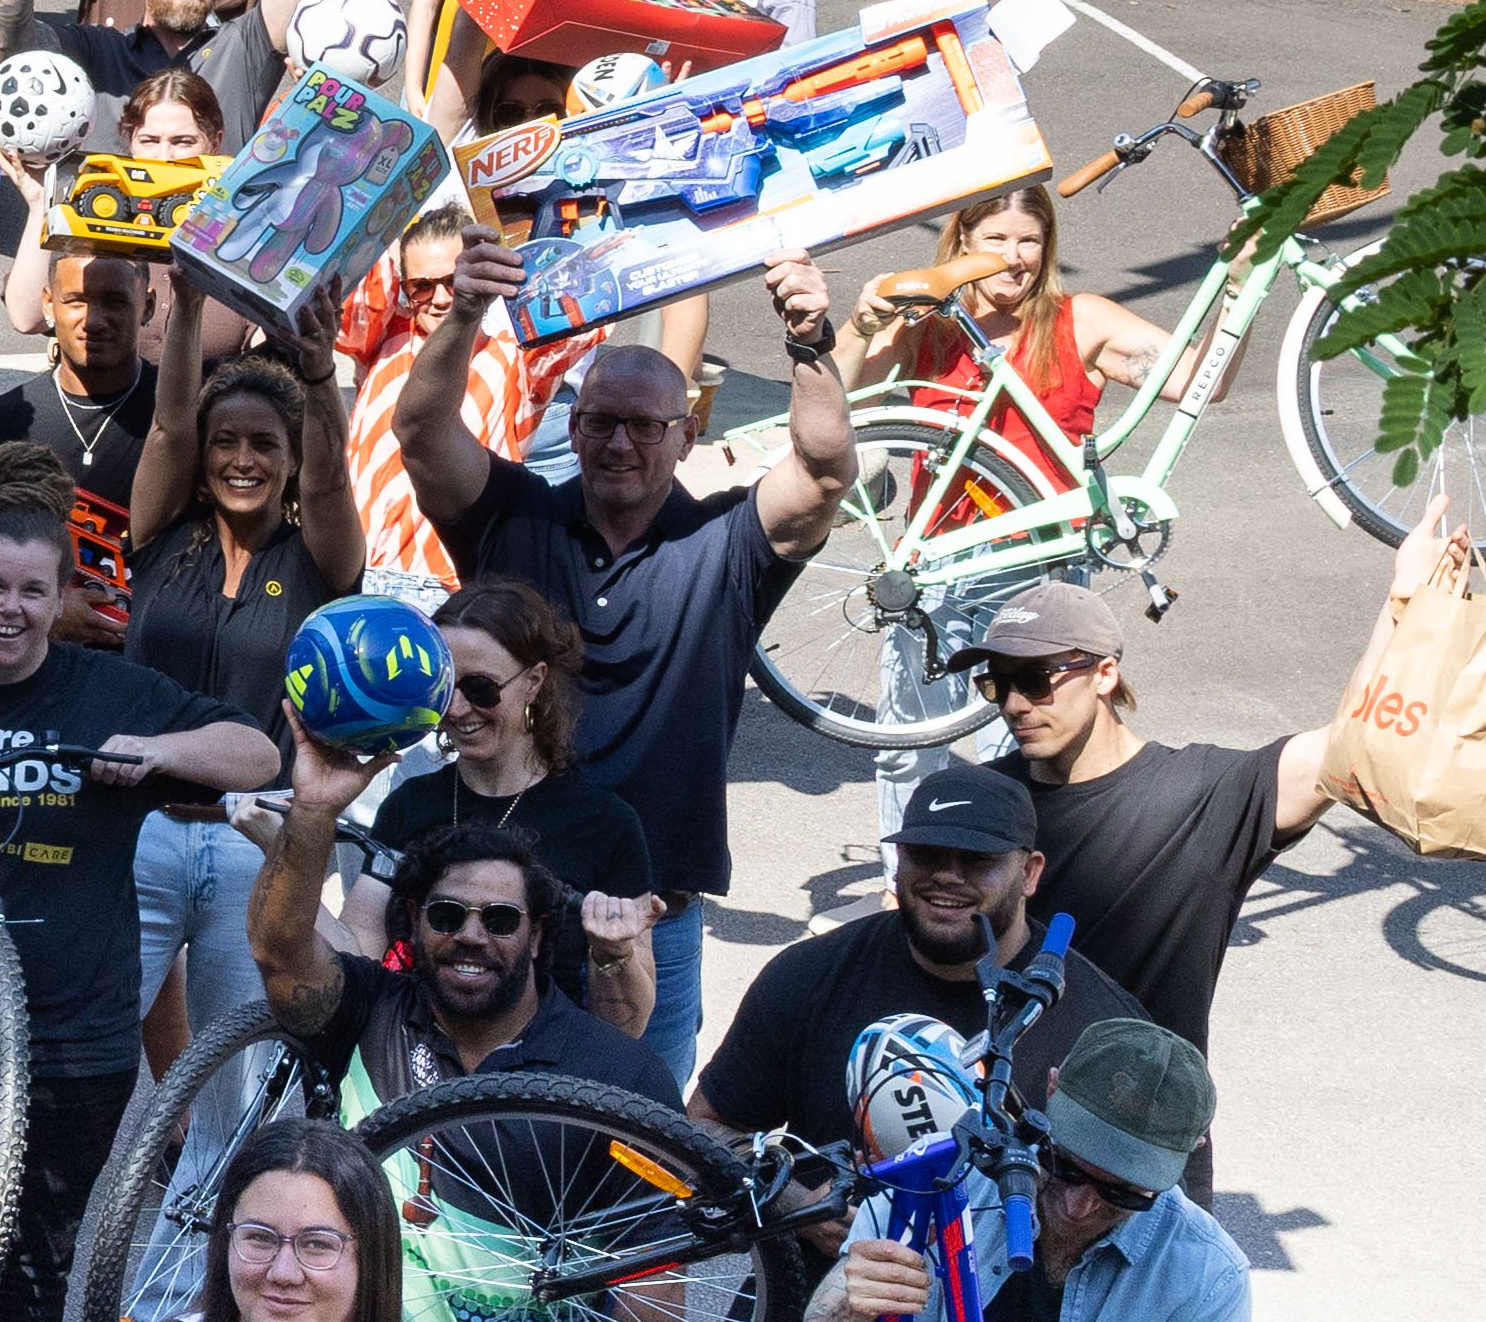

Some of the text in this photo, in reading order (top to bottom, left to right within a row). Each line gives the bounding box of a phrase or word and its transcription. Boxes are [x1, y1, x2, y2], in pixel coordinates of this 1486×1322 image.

[294, 84, 359, 131] PALZ
[309, 71, 365, 109] POUR
[132, 169, 146, 180] CAT
[469, 126, 553, 185] NERF
[1191, 346, 1226, 402] REPCO
[38, 793, 76, 807] 1981
[29, 845, 72, 863] CARE
